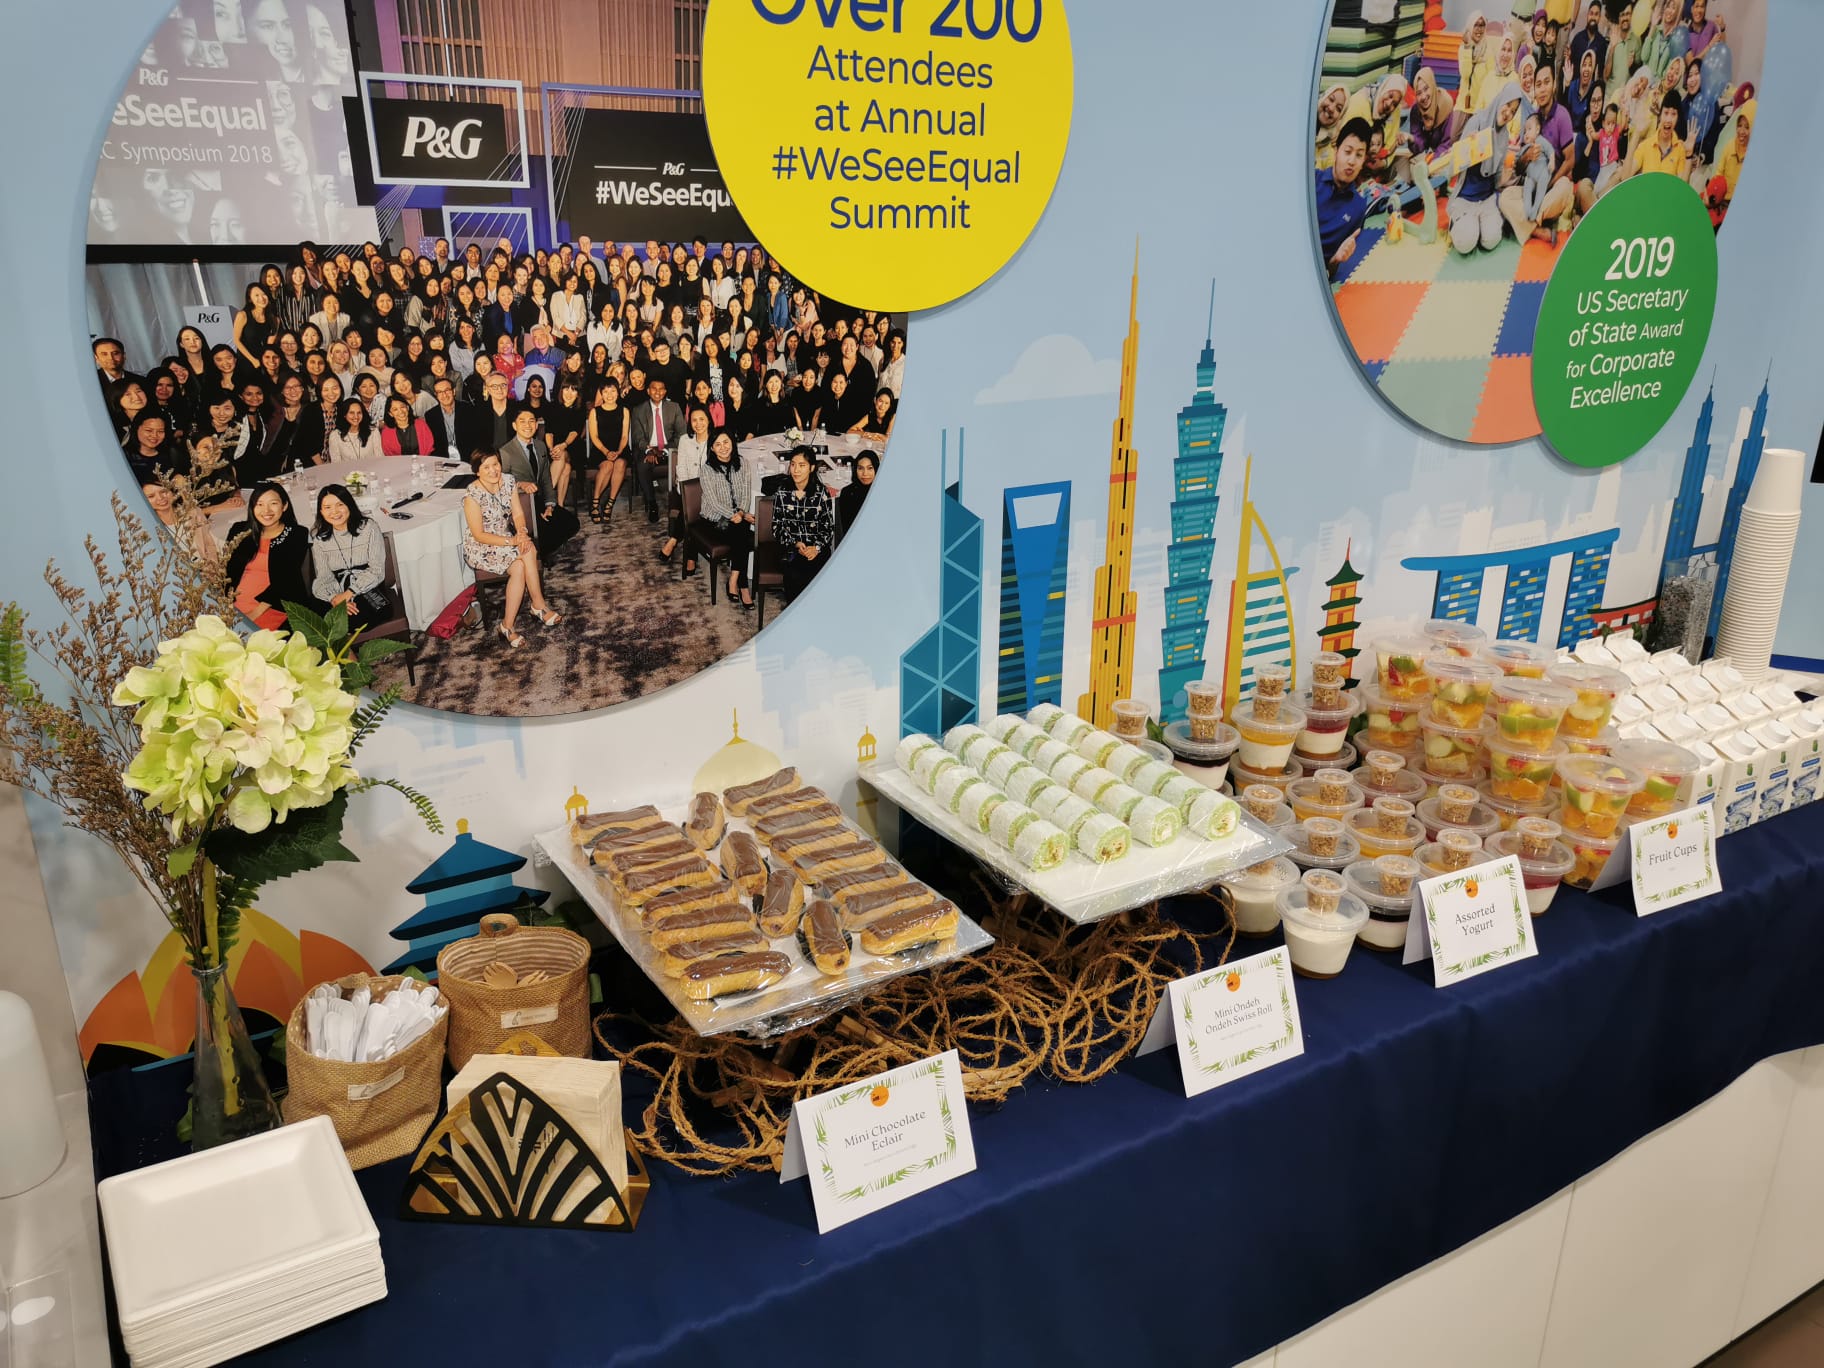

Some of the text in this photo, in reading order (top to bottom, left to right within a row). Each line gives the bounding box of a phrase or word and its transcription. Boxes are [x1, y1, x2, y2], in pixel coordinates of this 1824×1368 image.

[929, 0, 1042, 43] 200
[139, 69, 169, 87] P&G
[807, 44, 993, 89] Attendees
[815, 99, 985, 137] at Annual
[401, 116, 484, 160] P&G
[120, 142, 224, 166] Symposium
[228, 145, 273, 165] 2018
[772, 145, 1020, 190] #WeSeeEqual
[662, 162, 686, 176] P&G
[595, 180, 735, 213] #WeSeeEqu
[829, 196, 971, 230] Summit
[1604, 236, 1675, 280] 2019
[1577, 287, 1689, 315] US Secretary
[197, 312, 220, 324] P&G
[1568, 318, 1685, 347] of State Award
[1565, 348, 1675, 379] for Corporate
[1570, 380, 1662, 409] Excellence
[1649, 843, 1698, 865] Fruit Cups
[1455, 903, 1496, 925] Assorted
[1461, 919, 1494, 936] Yogurt
[1205, 1018, 1233, 1034] Ondeh
[1233, 1011, 1256, 1025] Swiss
[1256, 1003, 1273, 1017] Roll
[1214, 997, 1261, 1020] Mini Ondeh
[844, 1111, 927, 1148] Mini Chocolate
[871, 1132, 904, 1151] Eclair
